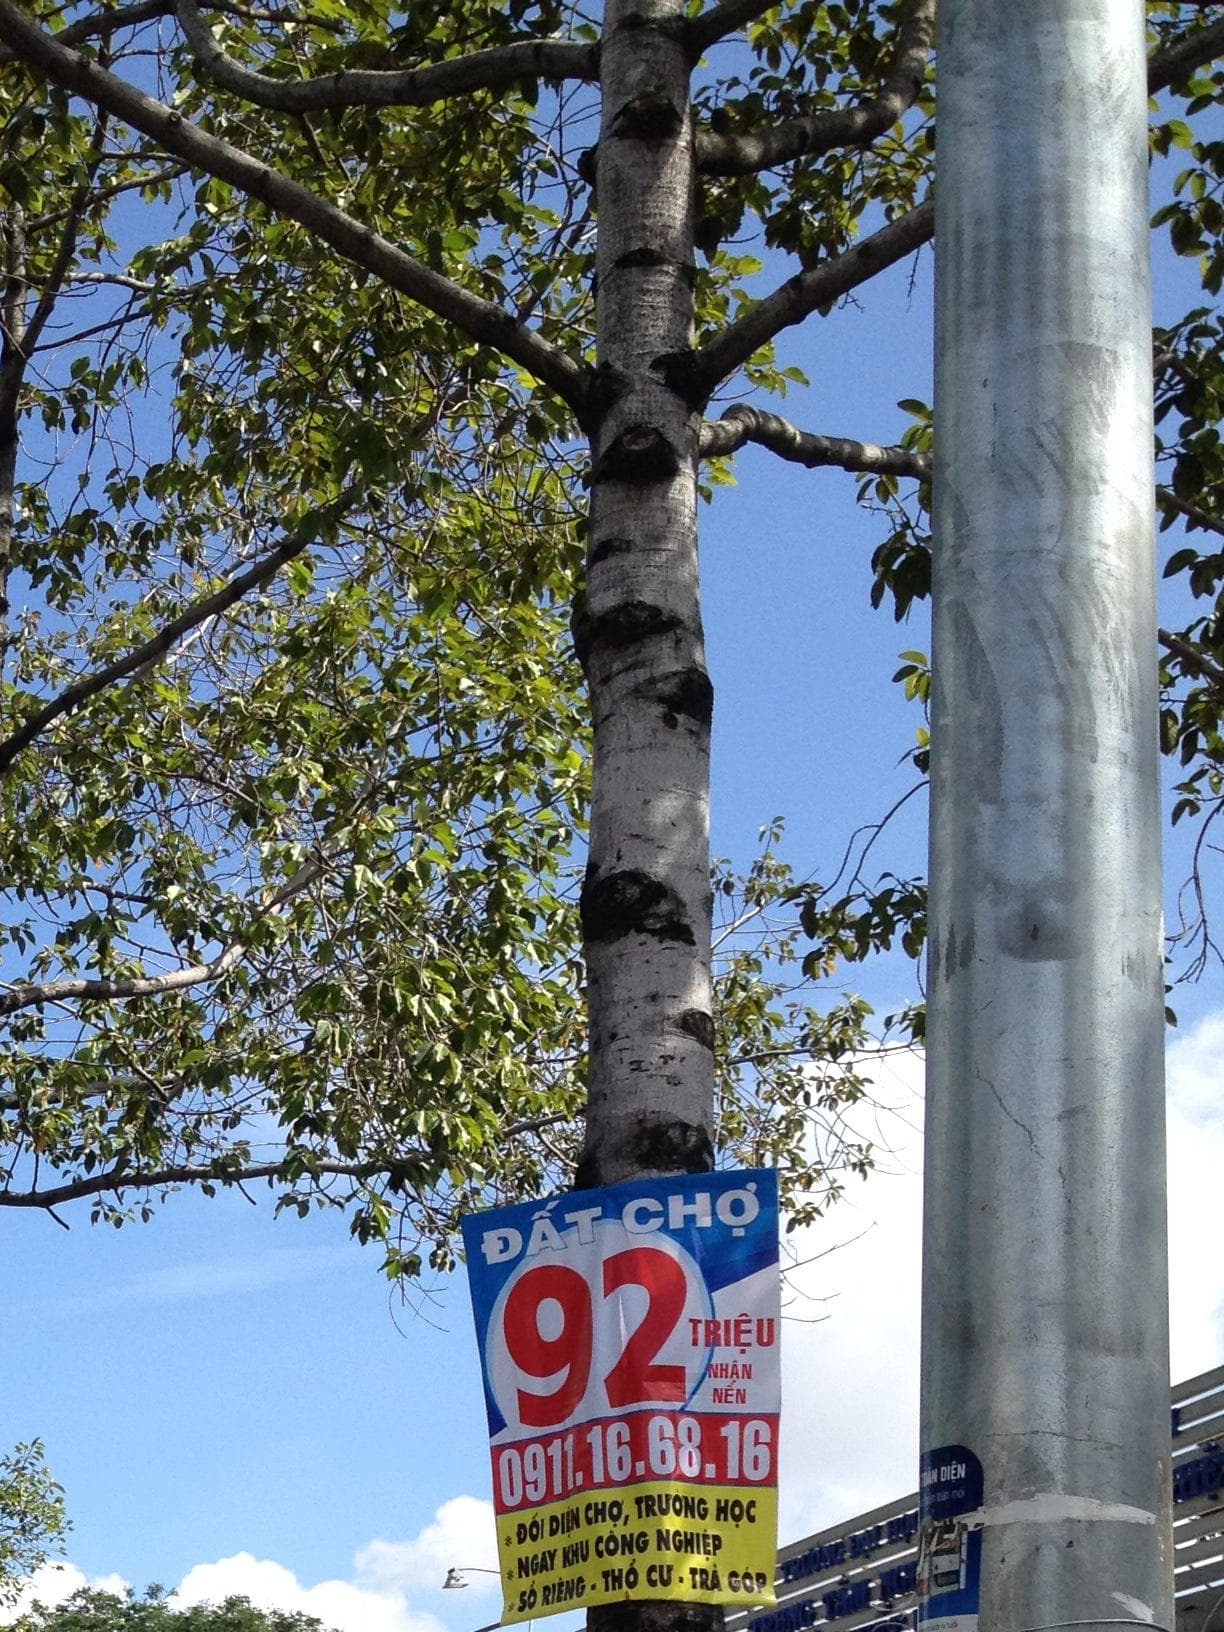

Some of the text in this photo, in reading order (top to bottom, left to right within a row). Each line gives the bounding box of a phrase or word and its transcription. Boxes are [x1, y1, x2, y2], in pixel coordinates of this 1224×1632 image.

[481, 1182, 760, 1265] ĐẤT CHỢ
[503, 1247, 688, 1428] 92
[688, 1312, 775, 1354] TRIỆU
[499, 1416, 771, 1507] 0911.16.68.16
[939, 1460, 966, 1483] DIỆN
[516, 1513, 544, 1545] ĐỐI
[716, 1498, 757, 1529] HỌC
[517, 1528, 723, 1579] NGAY KHU CÔNG NGHIỆP
[542, 1575, 586, 1607] RIÊNG
